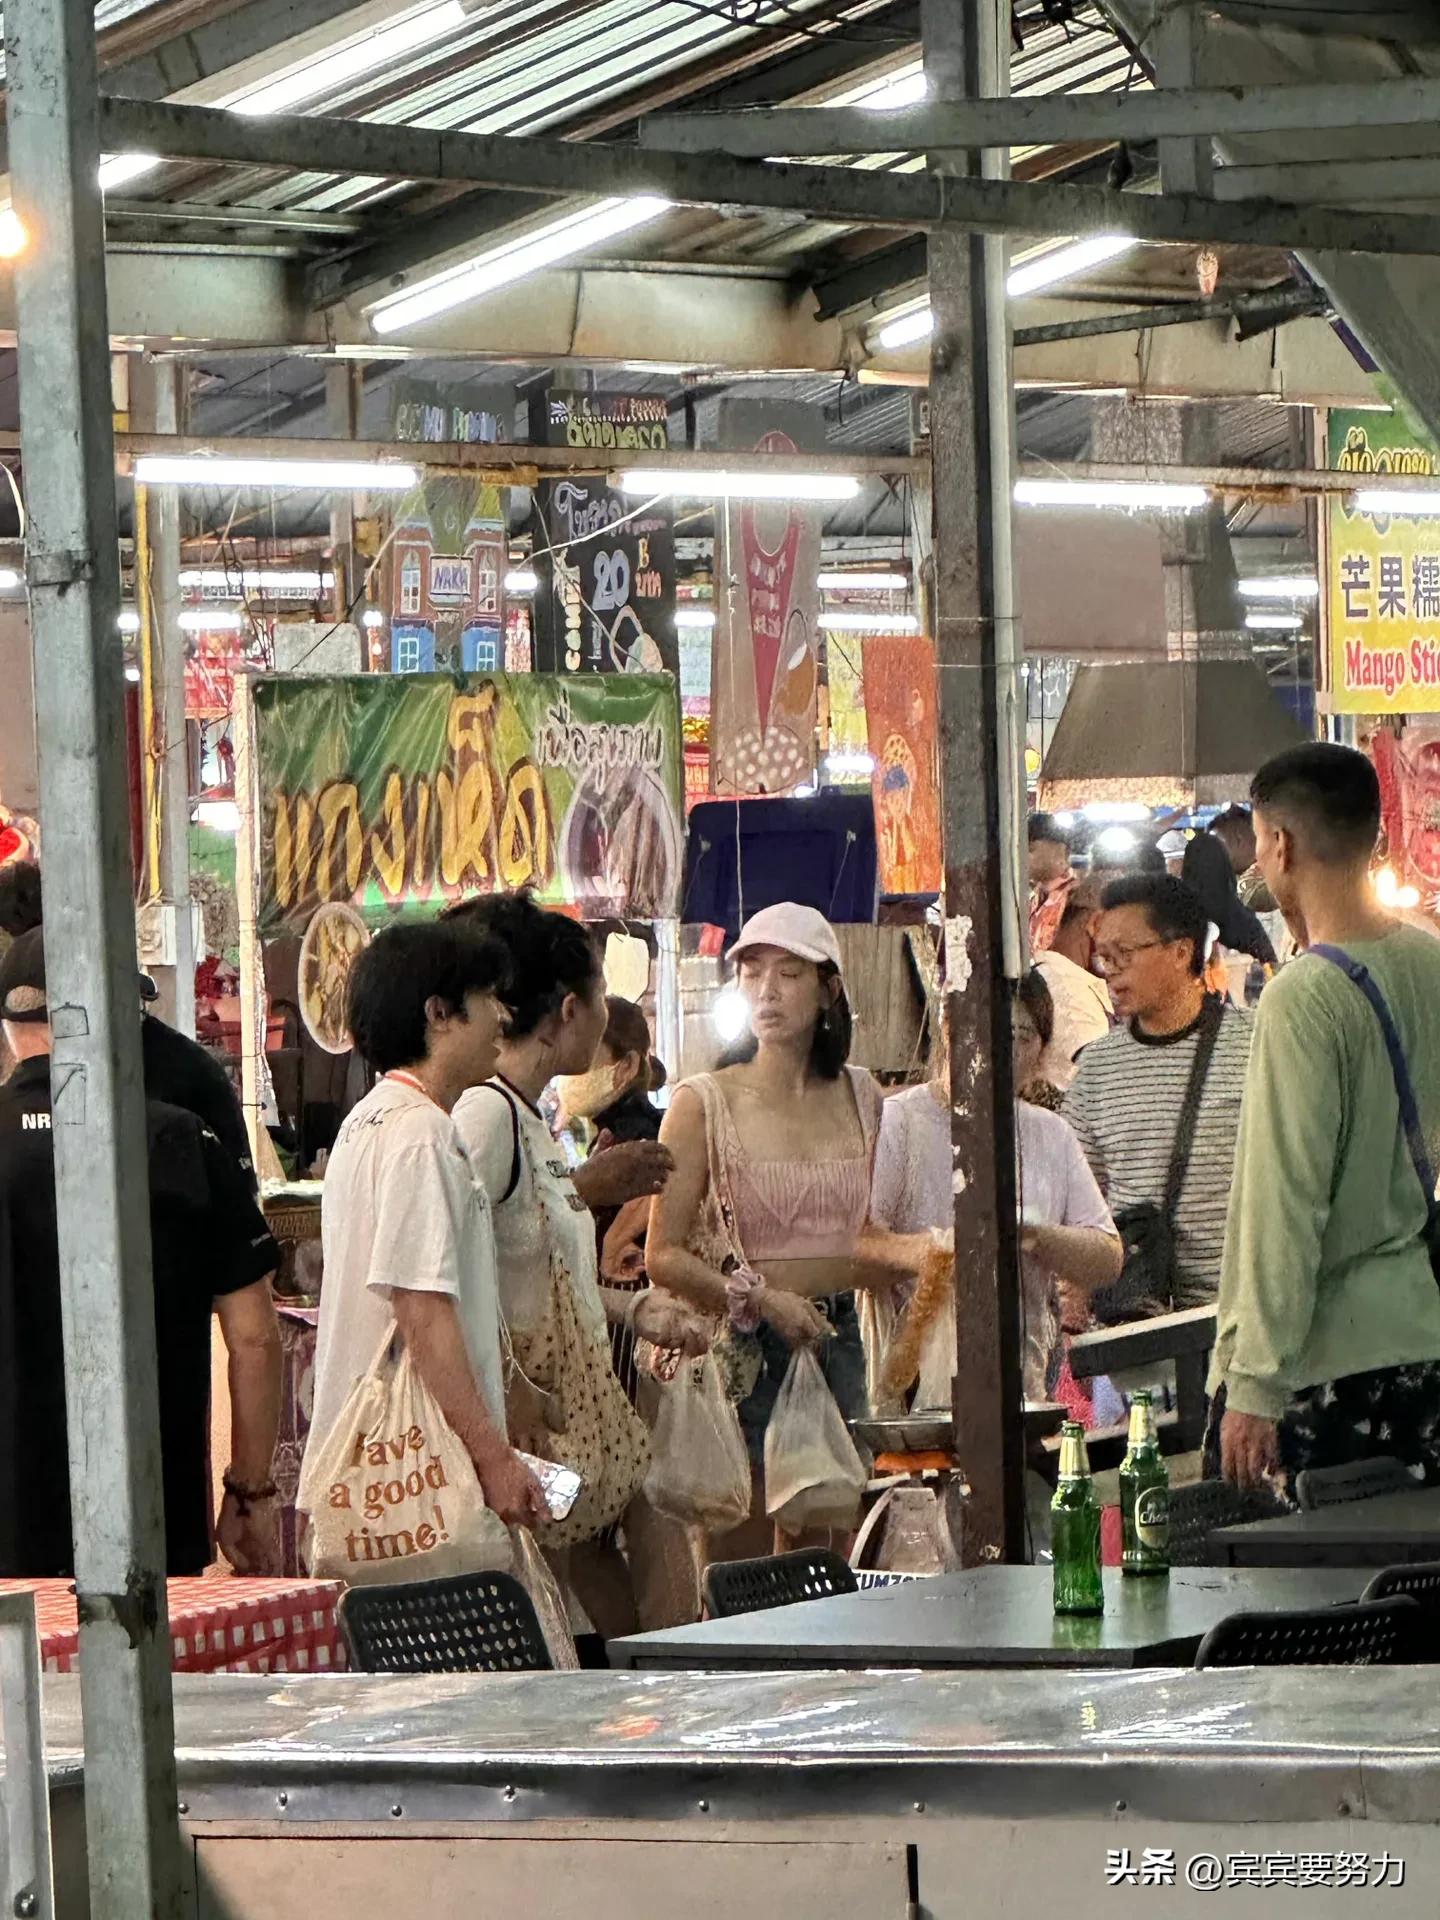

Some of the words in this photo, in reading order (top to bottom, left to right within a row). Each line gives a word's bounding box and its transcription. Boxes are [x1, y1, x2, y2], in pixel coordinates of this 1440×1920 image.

[1346, 641, 1404, 695] Mango
[329, 1483, 351, 1508] a
[364, 1456, 449, 1519] good
[345, 1505, 449, 1561] time!
